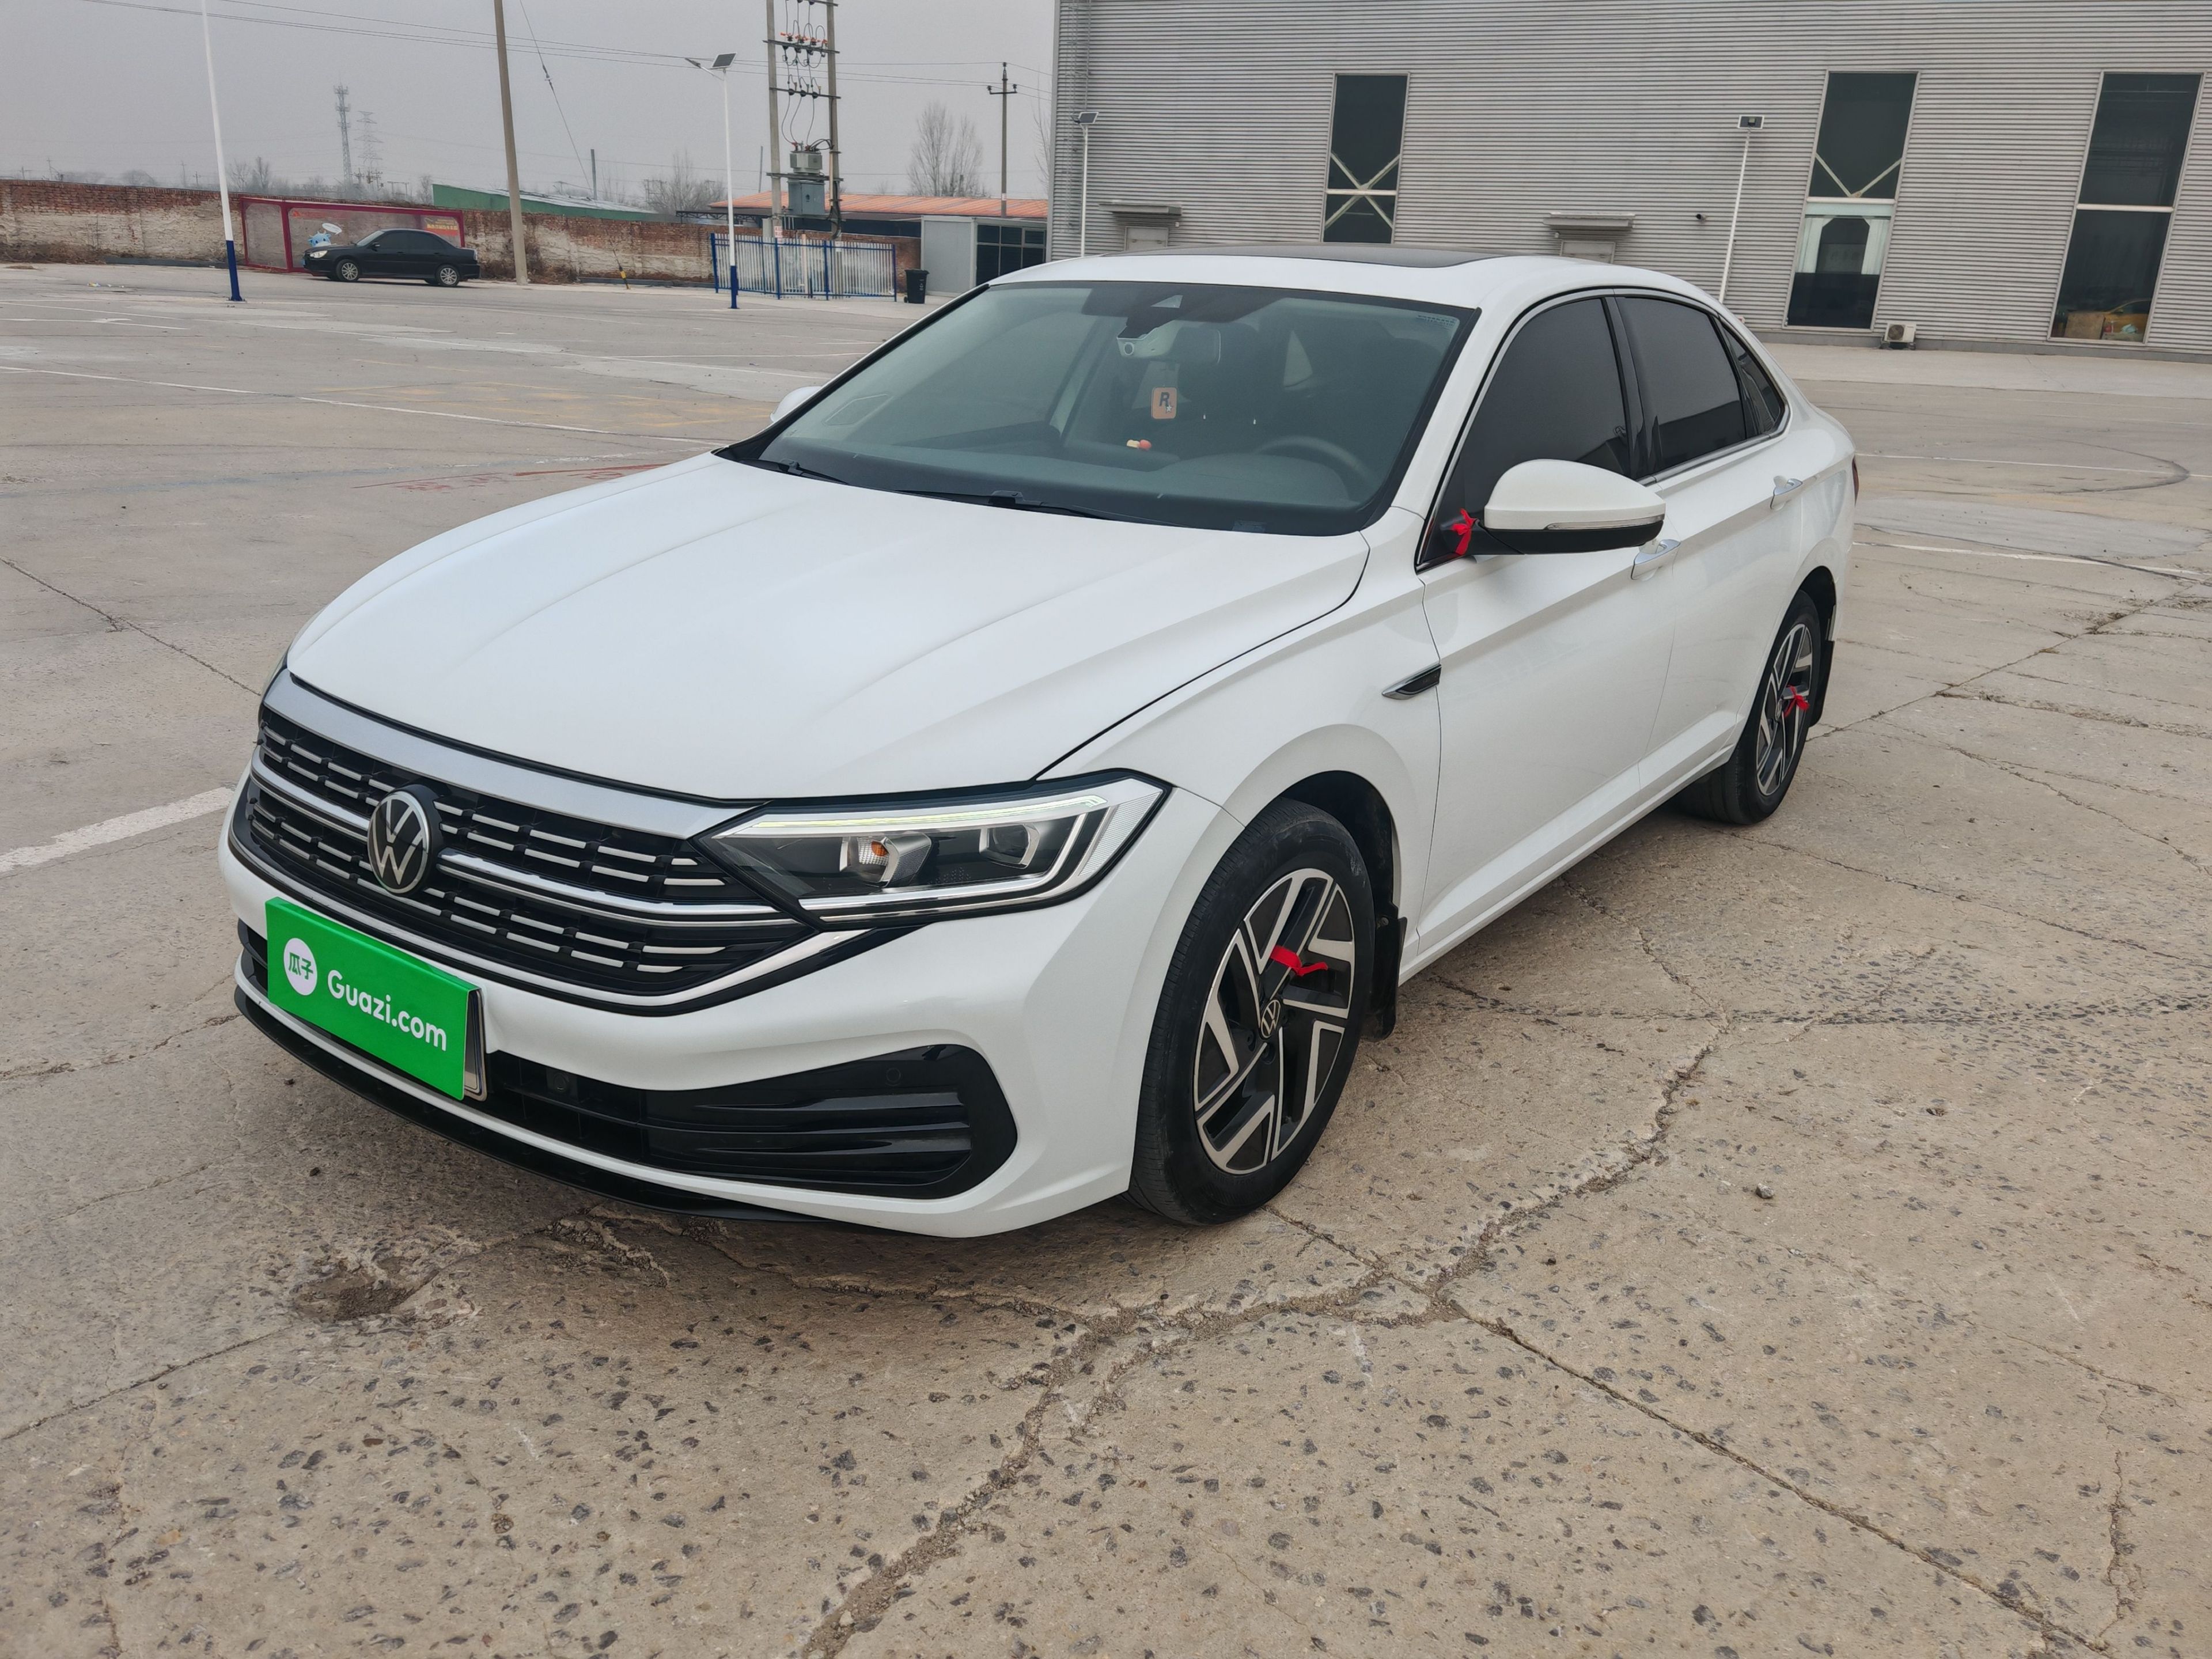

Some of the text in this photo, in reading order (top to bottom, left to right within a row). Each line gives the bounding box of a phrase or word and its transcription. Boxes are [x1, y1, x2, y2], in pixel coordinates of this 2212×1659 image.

[1159, 392, 1171, 407] R
[289, 952, 314, 980] 瓜子
[328, 970, 446, 1051] Guazi.com
